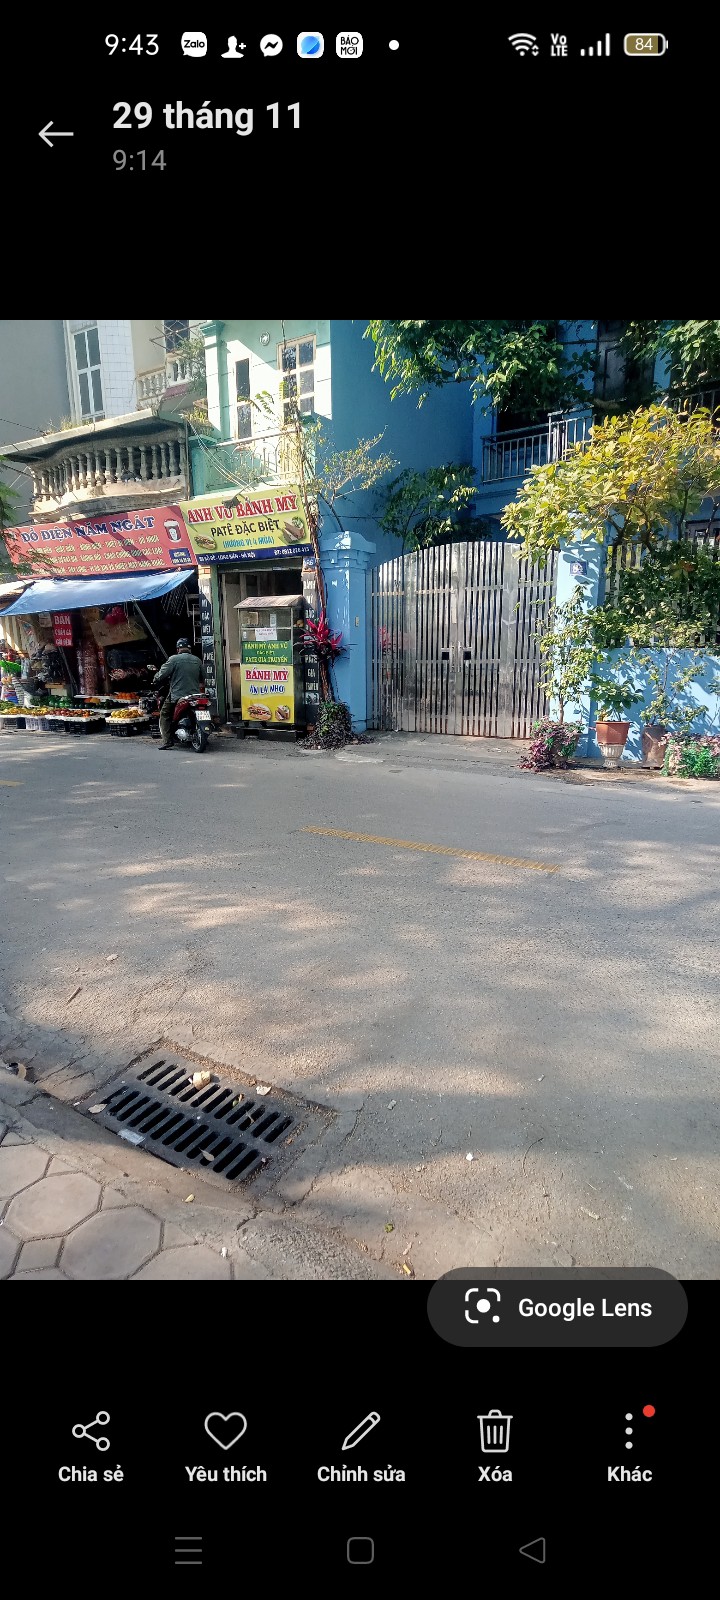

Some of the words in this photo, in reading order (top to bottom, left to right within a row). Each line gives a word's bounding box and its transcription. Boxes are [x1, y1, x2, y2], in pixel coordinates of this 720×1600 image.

[187, 506, 215, 524] ANH
[210, 522, 234, 537] PATÊ
[234, 520, 257, 536] ĐẶC
[257, 519, 281, 534] BIỆT
[245, 667, 271, 681] BÁNH
